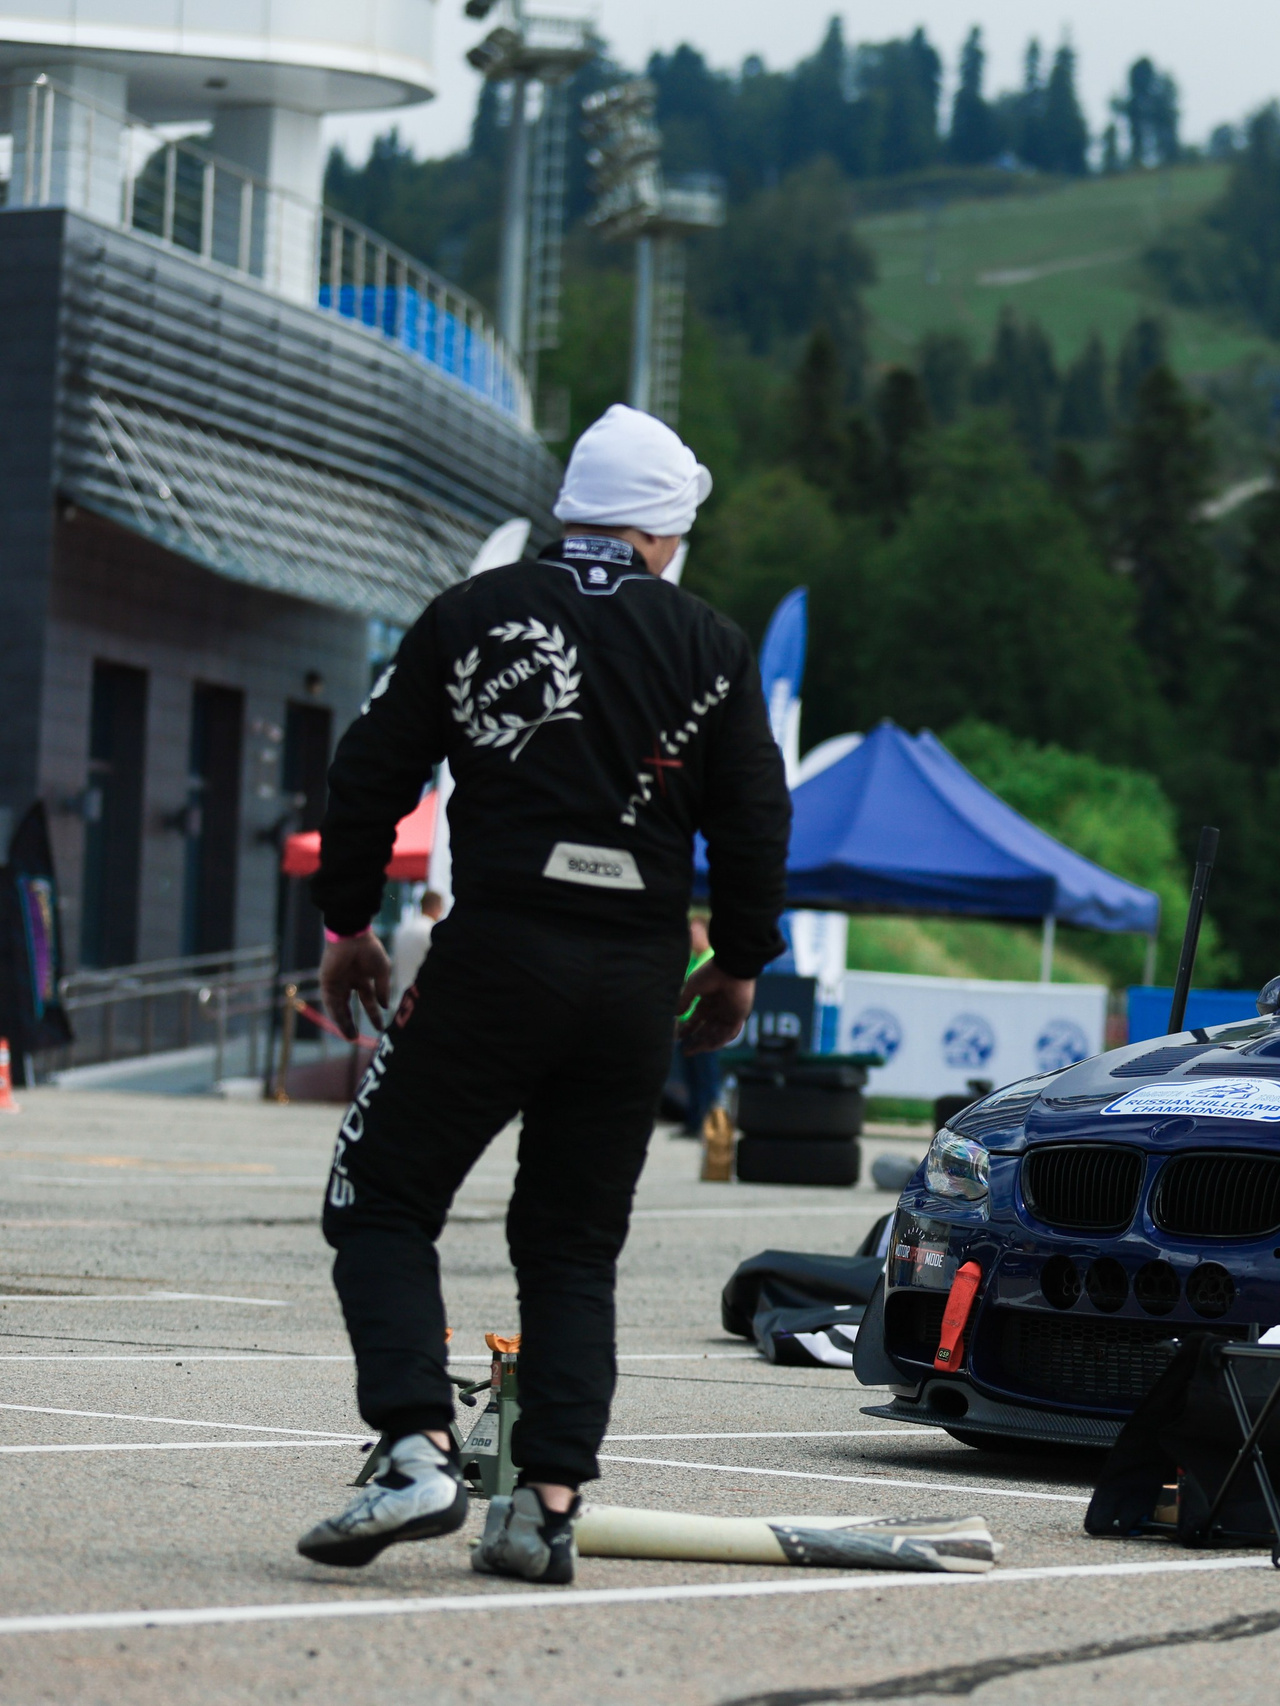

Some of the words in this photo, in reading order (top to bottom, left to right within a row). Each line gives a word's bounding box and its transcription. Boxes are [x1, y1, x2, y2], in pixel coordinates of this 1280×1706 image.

[1125, 1098, 1191, 1107] RUSSIAN
[1131, 1105, 1255, 1117] CHAMPIONSHIP
[925, 1252, 945, 1268] MODE
